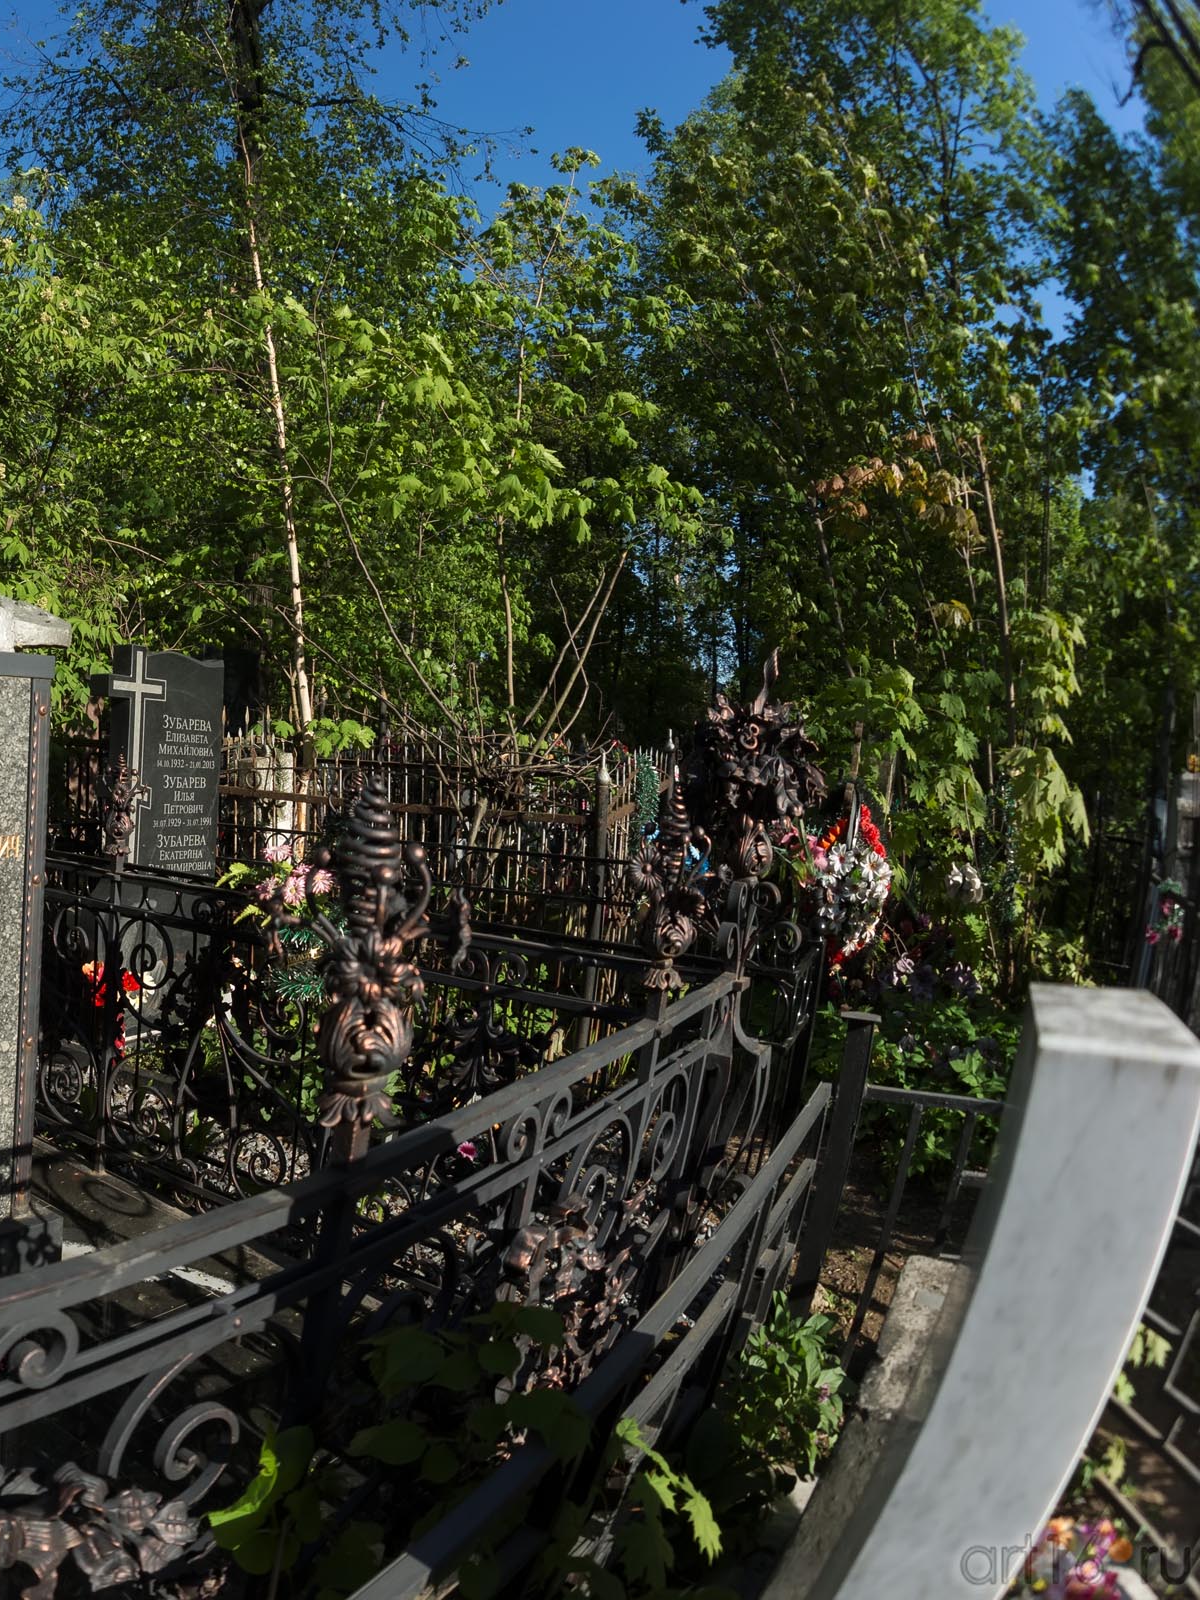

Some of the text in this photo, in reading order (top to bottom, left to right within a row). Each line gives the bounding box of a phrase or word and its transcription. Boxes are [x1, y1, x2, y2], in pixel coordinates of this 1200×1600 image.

[162, 714, 212, 732] ЗУБАРЕВА
[165, 731, 209, 744] ЕЛИЗАВЕТА
[158, 743, 214, 757] МИХАЙЛОВНА
[163, 774, 206, 789] ЗУБАРЕВ
[173, 790, 195, 802] ИЛЬЯ
[163, 803, 204, 815] ПЕТРОВИЧ
[156, 833, 207, 849] ЗУБАРЕВА
